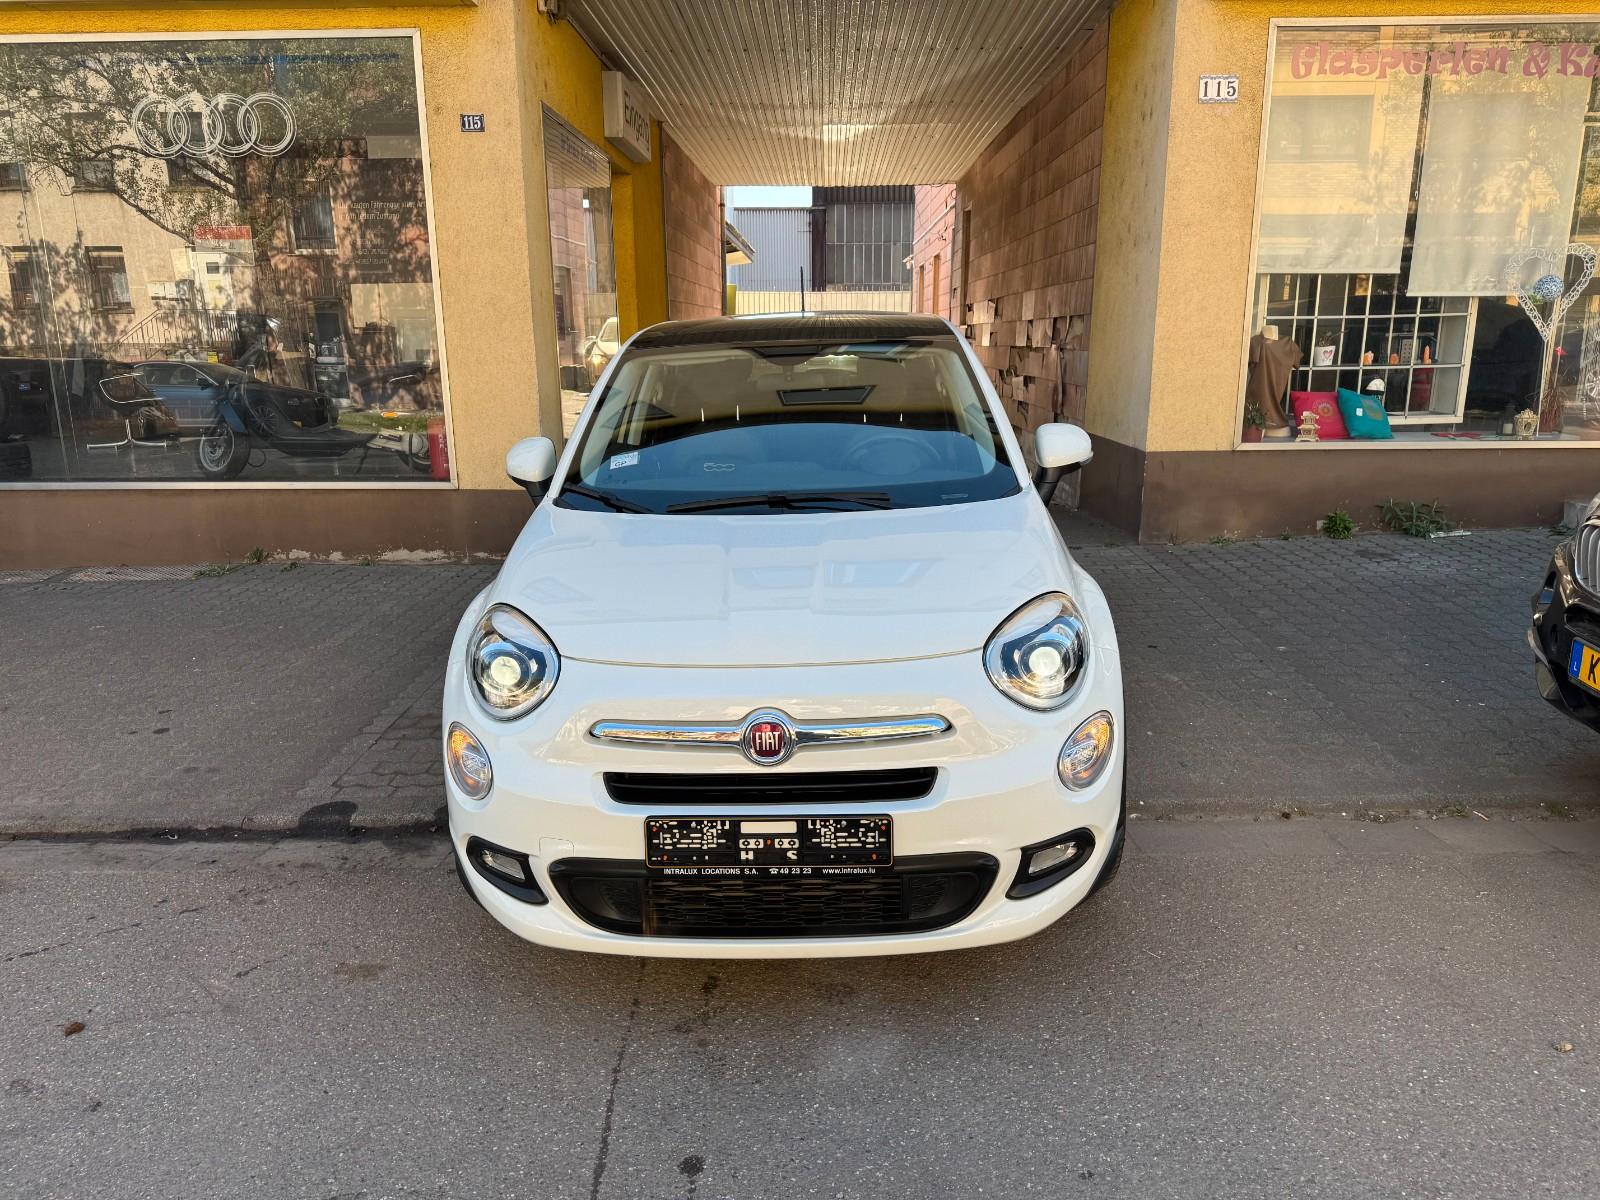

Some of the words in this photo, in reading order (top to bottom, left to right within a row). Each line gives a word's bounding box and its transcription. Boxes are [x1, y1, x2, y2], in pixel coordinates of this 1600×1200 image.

[1291, 41, 1508, 80] Glasperlen
[1522, 42, 1551, 80] &
[1203, 80, 1236, 97] 115
[463, 115, 482, 130] 115
[755, 731, 781, 751] FIAT
